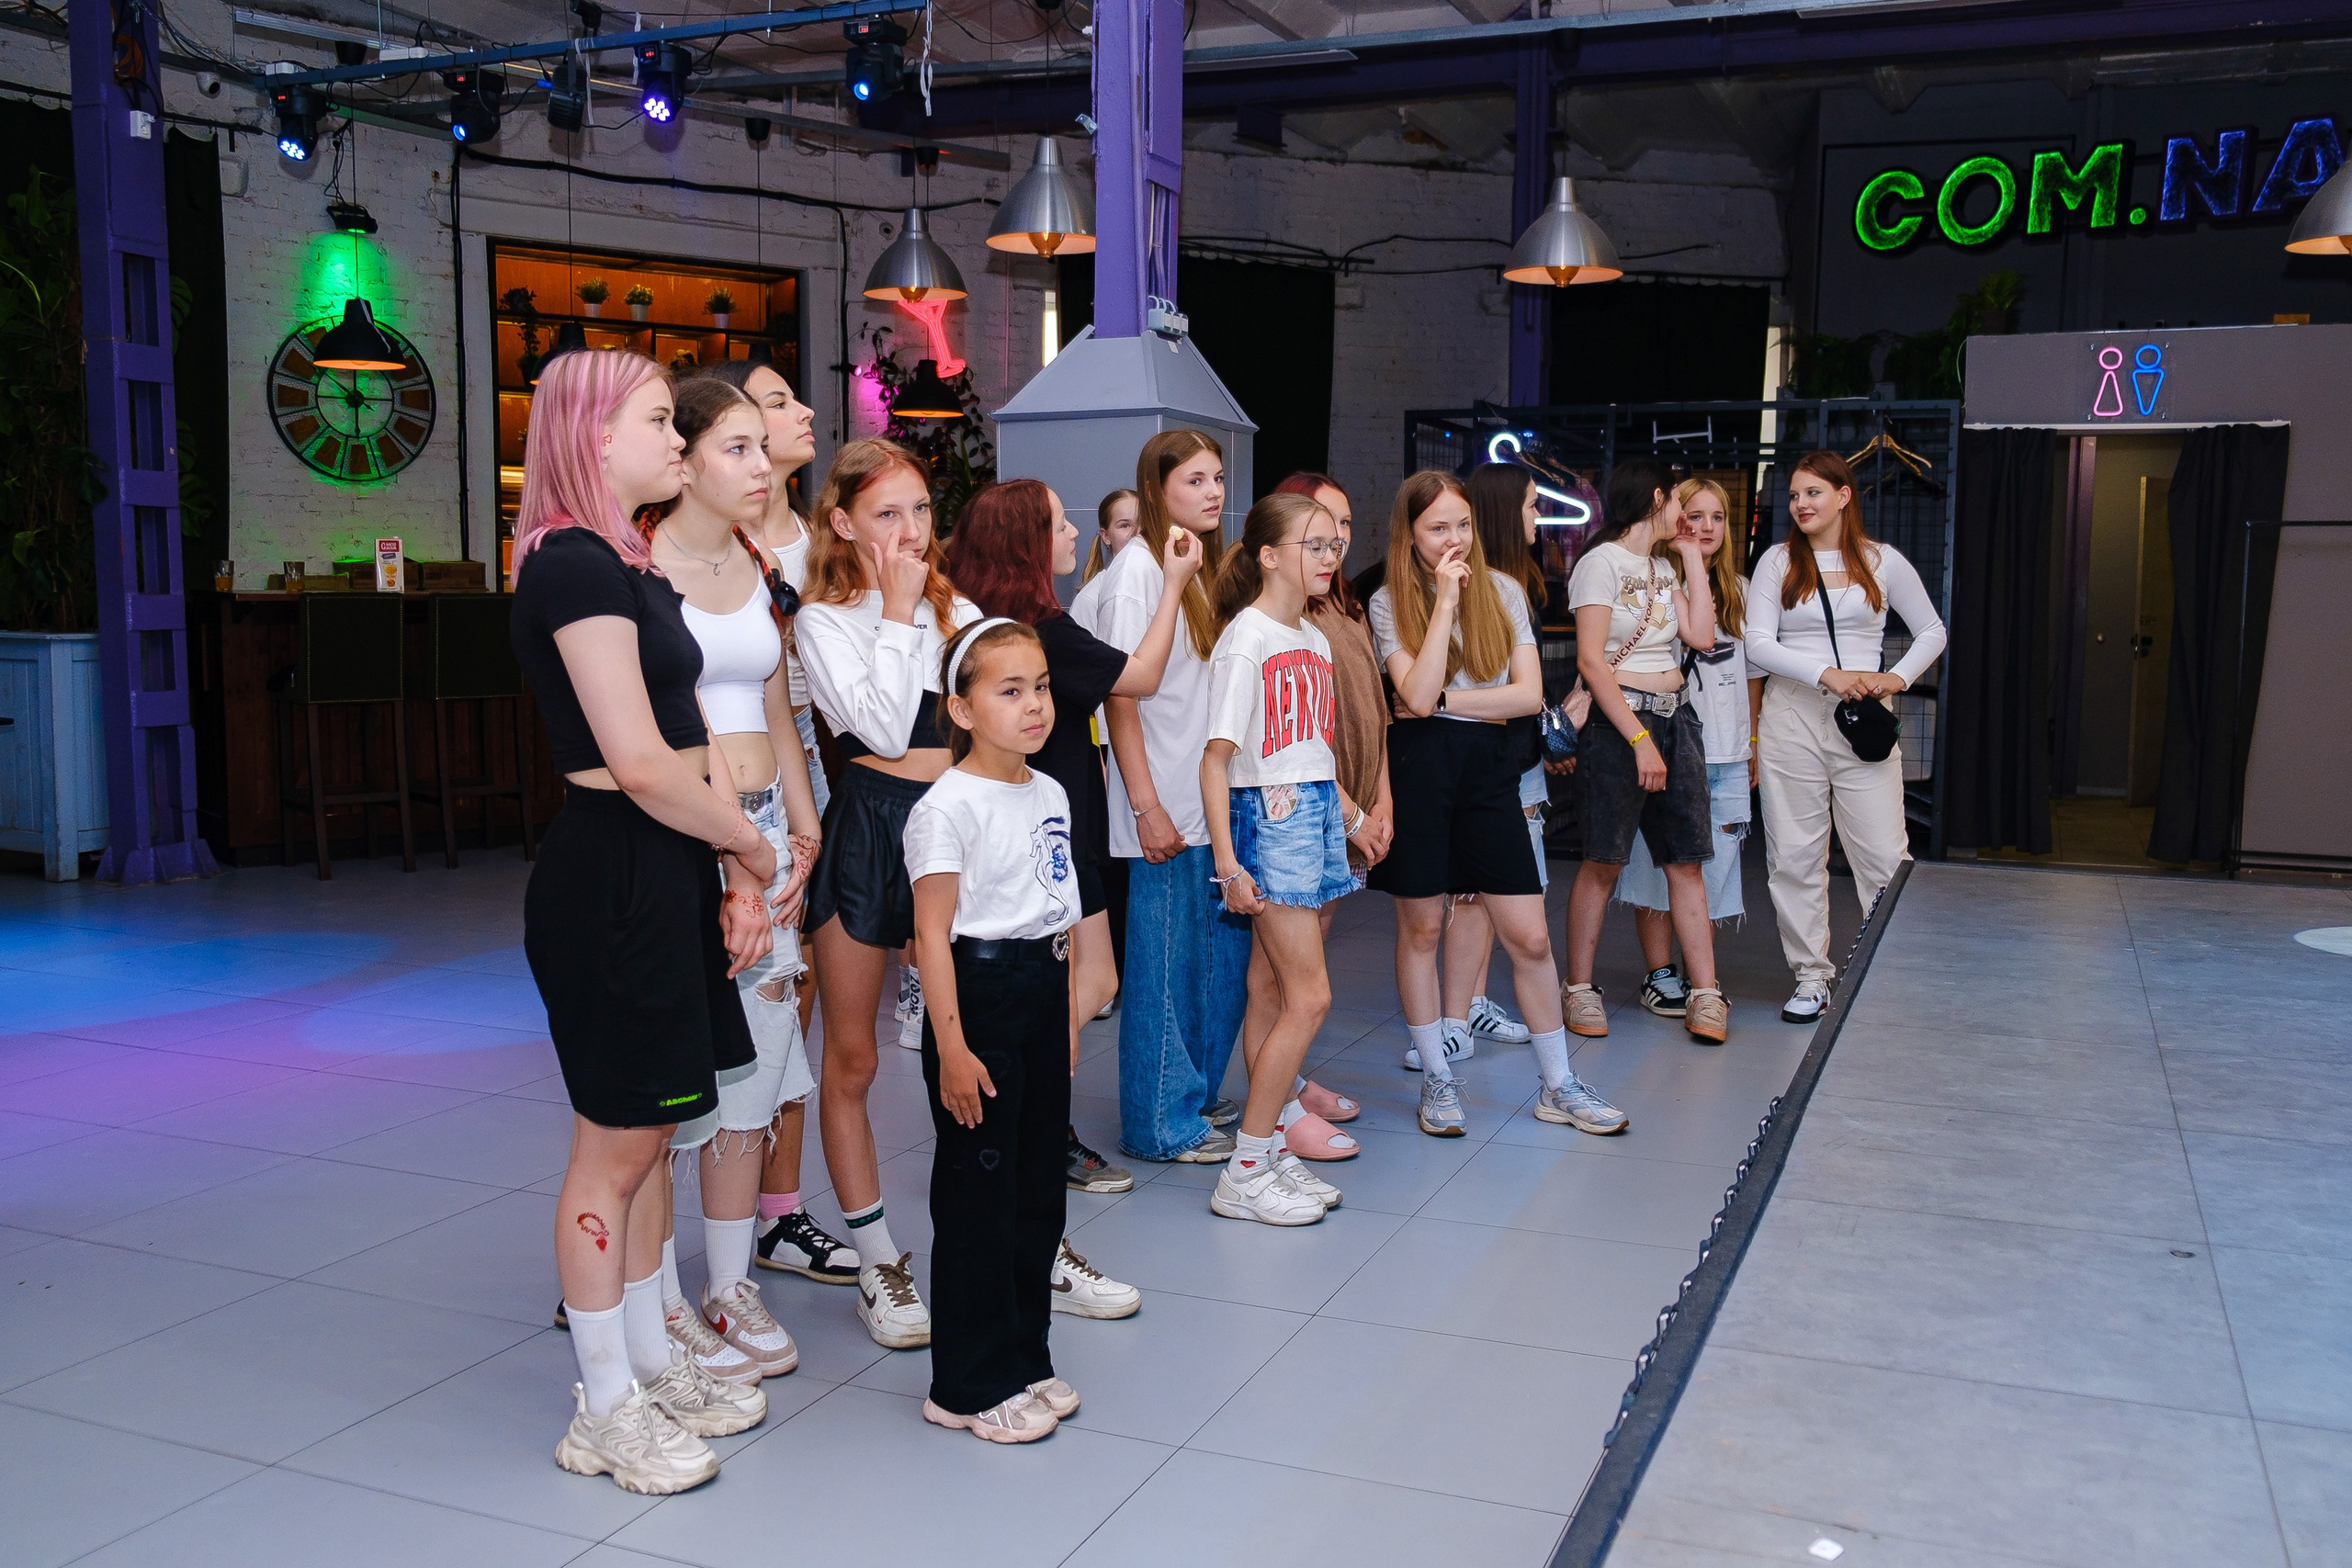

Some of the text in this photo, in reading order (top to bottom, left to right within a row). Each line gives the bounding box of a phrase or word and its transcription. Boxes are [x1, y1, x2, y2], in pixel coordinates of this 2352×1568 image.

[1611, 597, 1654, 667] MICHAEL KORS
[1261, 649, 1314, 760] NEW
